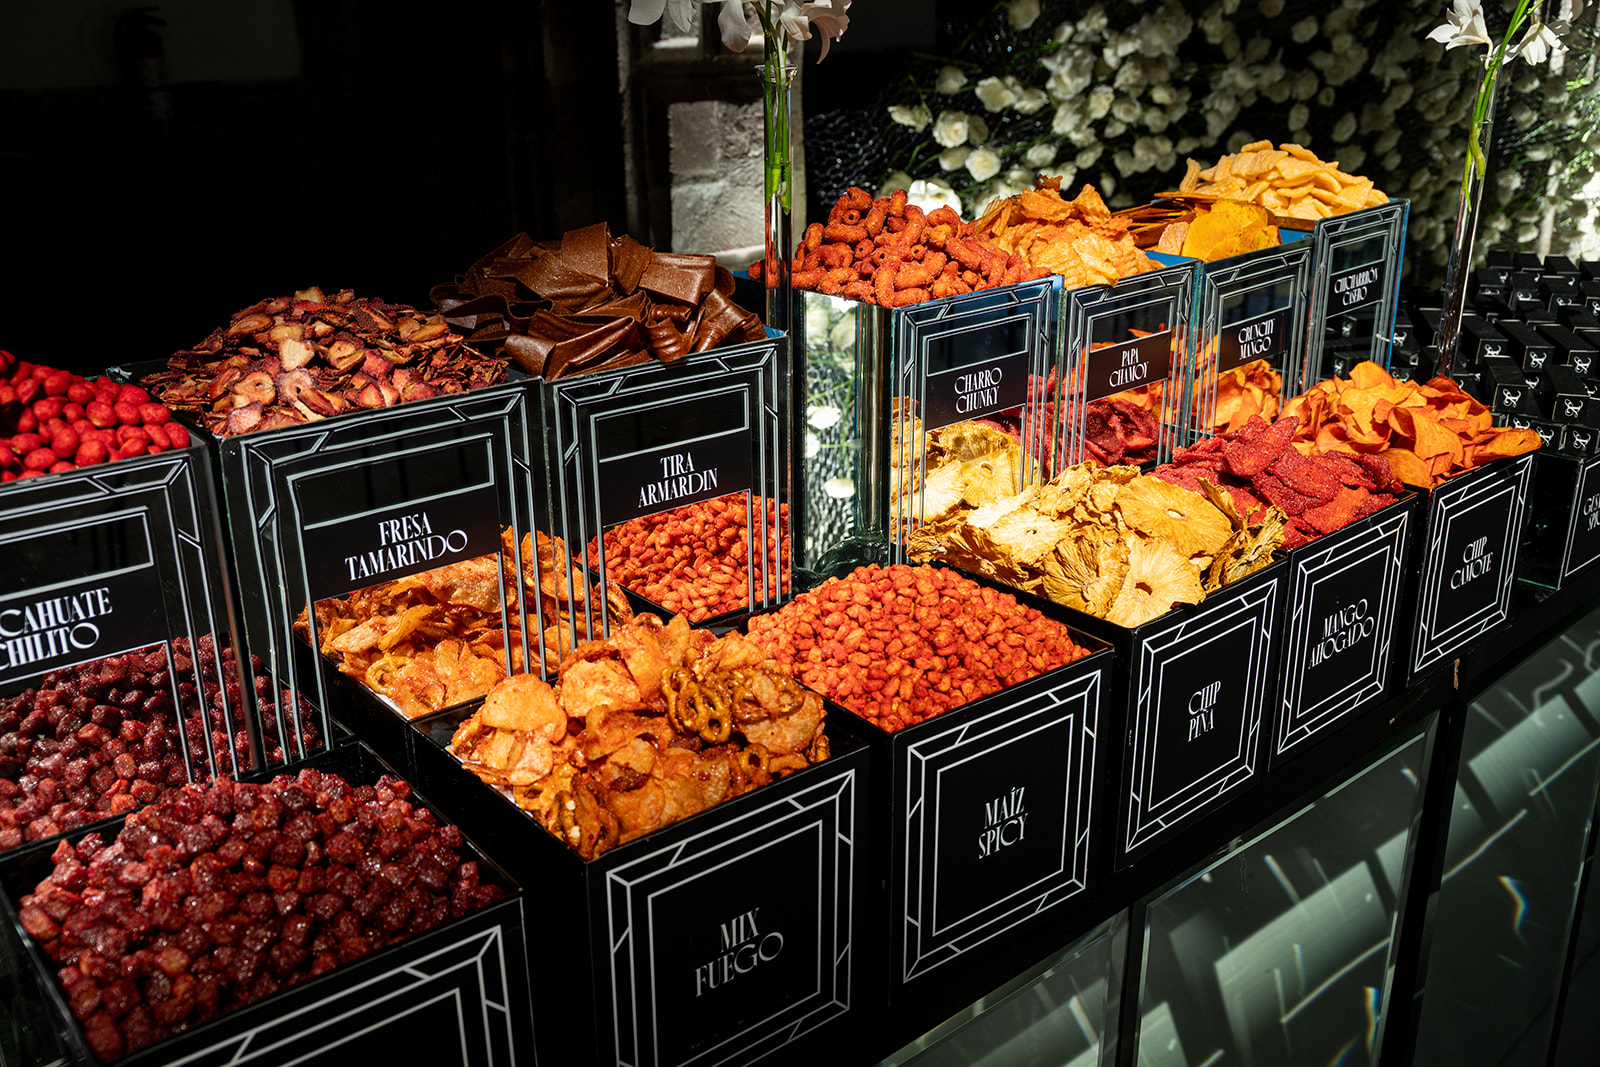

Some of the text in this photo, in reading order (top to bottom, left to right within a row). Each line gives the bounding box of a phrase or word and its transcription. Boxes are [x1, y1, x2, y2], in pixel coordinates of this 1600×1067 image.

[1238, 318, 1275, 343] CRUNCHY
[1239, 336, 1271, 360] MANGO
[1109, 361, 1149, 387] CHAMOY
[1121, 348, 1139, 367] PAPA
[954, 367, 1003, 394] CHARRO
[956, 386, 1000, 413] CHUNKY
[660, 452, 695, 478] TIRA
[638, 468, 718, 508] ARMARDIN
[378, 512, 432, 546] FRESA
[344, 529, 468, 581] TAMARINDO
[1463, 536, 1488, 563] CHIP
[1450, 552, 1494, 590] CAMOTE
[1322, 598, 1368, 640] MANGO
[1308, 616, 1375, 670] AHOGADO
[1188, 680, 1221, 715] CHIP
[1187, 708, 1214, 743] PIÑA
[984, 786, 1025, 829] MAÍZ
[978, 812, 1029, 860] SPICY
[720, 906, 760, 953] MIX
[695, 931, 784, 998] FUEGO
